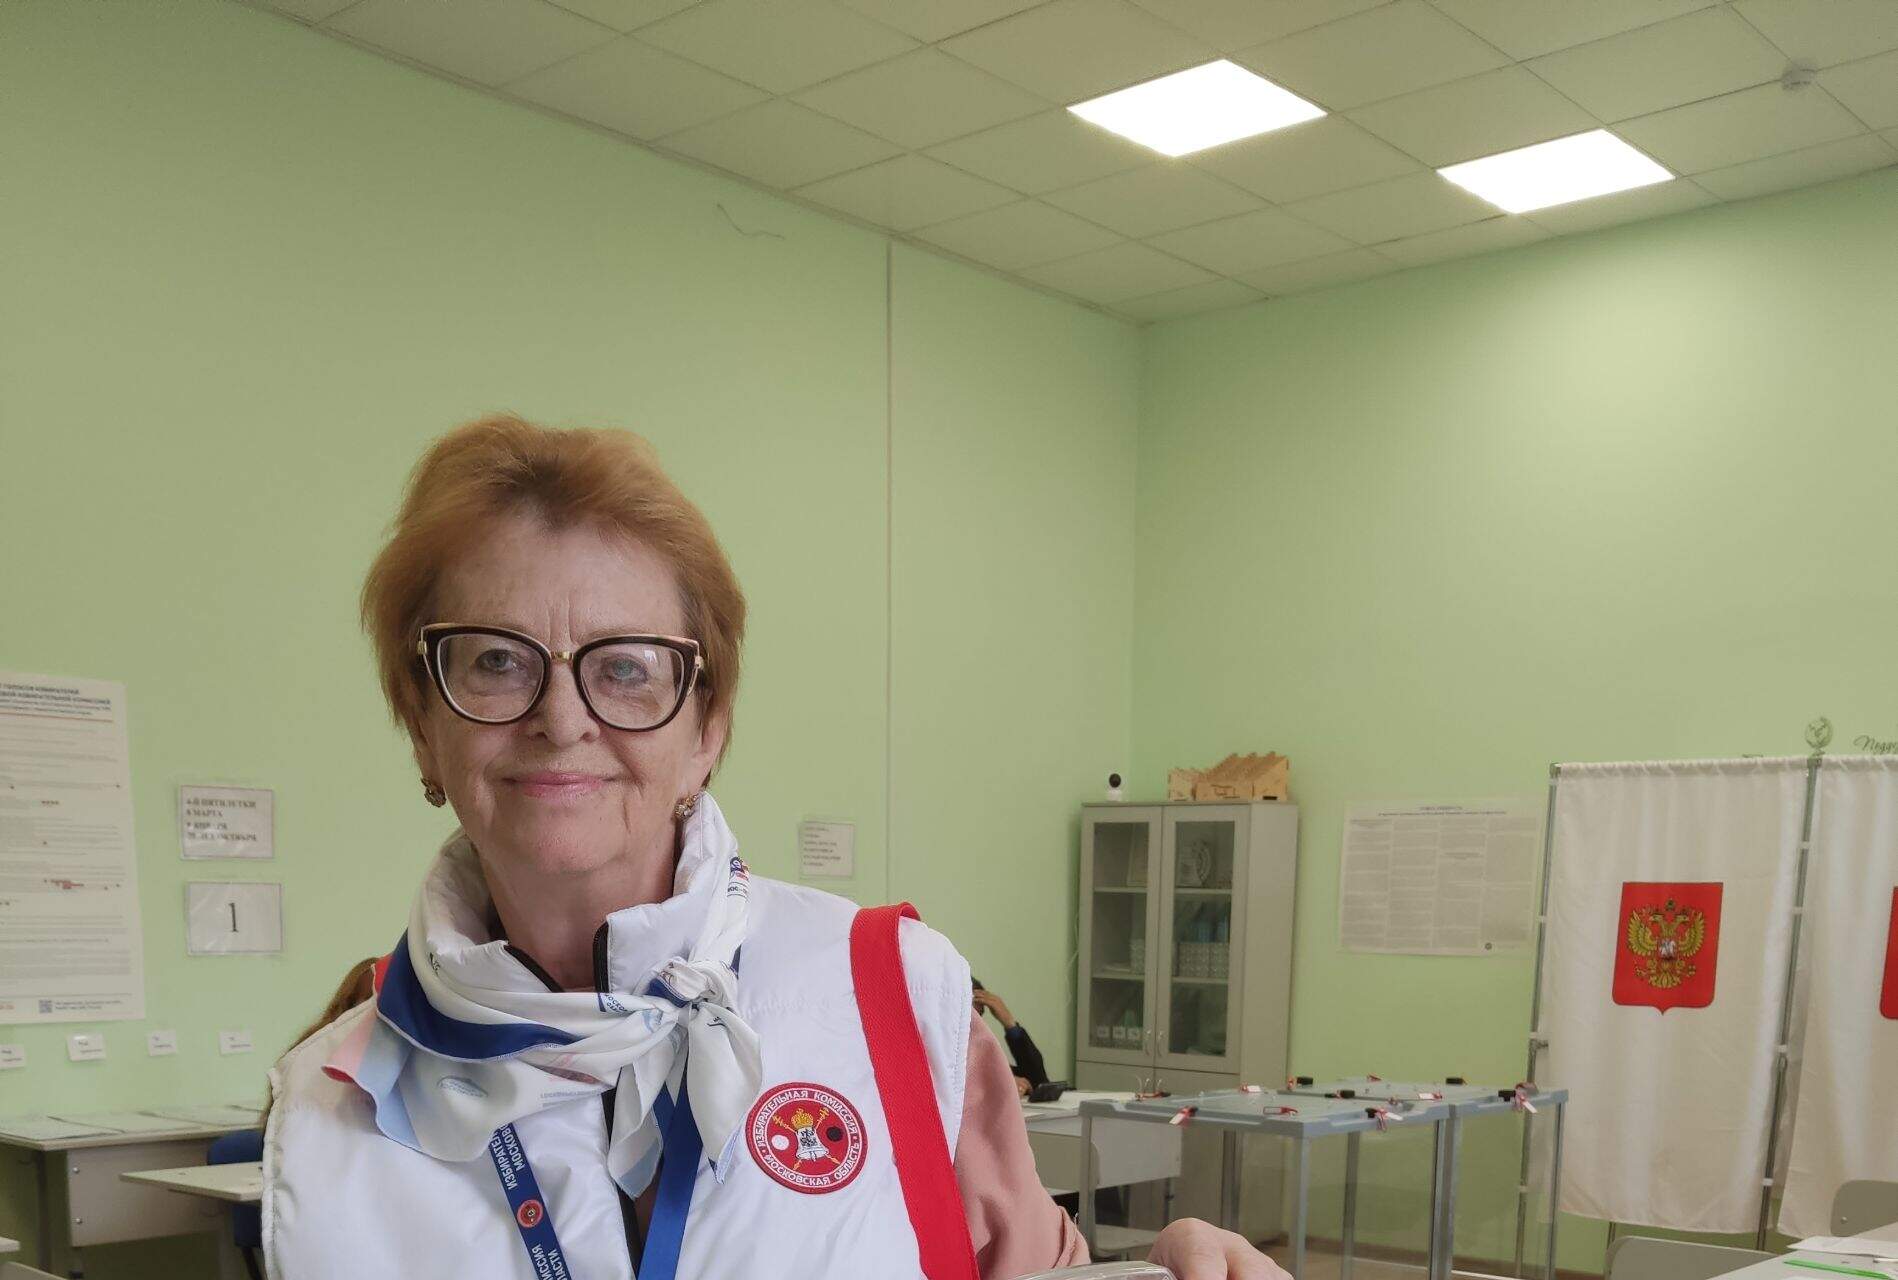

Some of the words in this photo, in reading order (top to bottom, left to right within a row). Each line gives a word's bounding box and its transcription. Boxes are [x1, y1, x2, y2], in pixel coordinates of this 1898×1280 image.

[228, 902, 239, 932] 1
[755, 1090, 808, 1147] ИЗБИРАТЕЛЬНАЯ
[813, 1092, 858, 1136] КОМИССИЯ
[763, 1154, 831, 1186] МОСКОВСКАЯ
[834, 1142, 860, 1179] ОБЛАСТЬ
